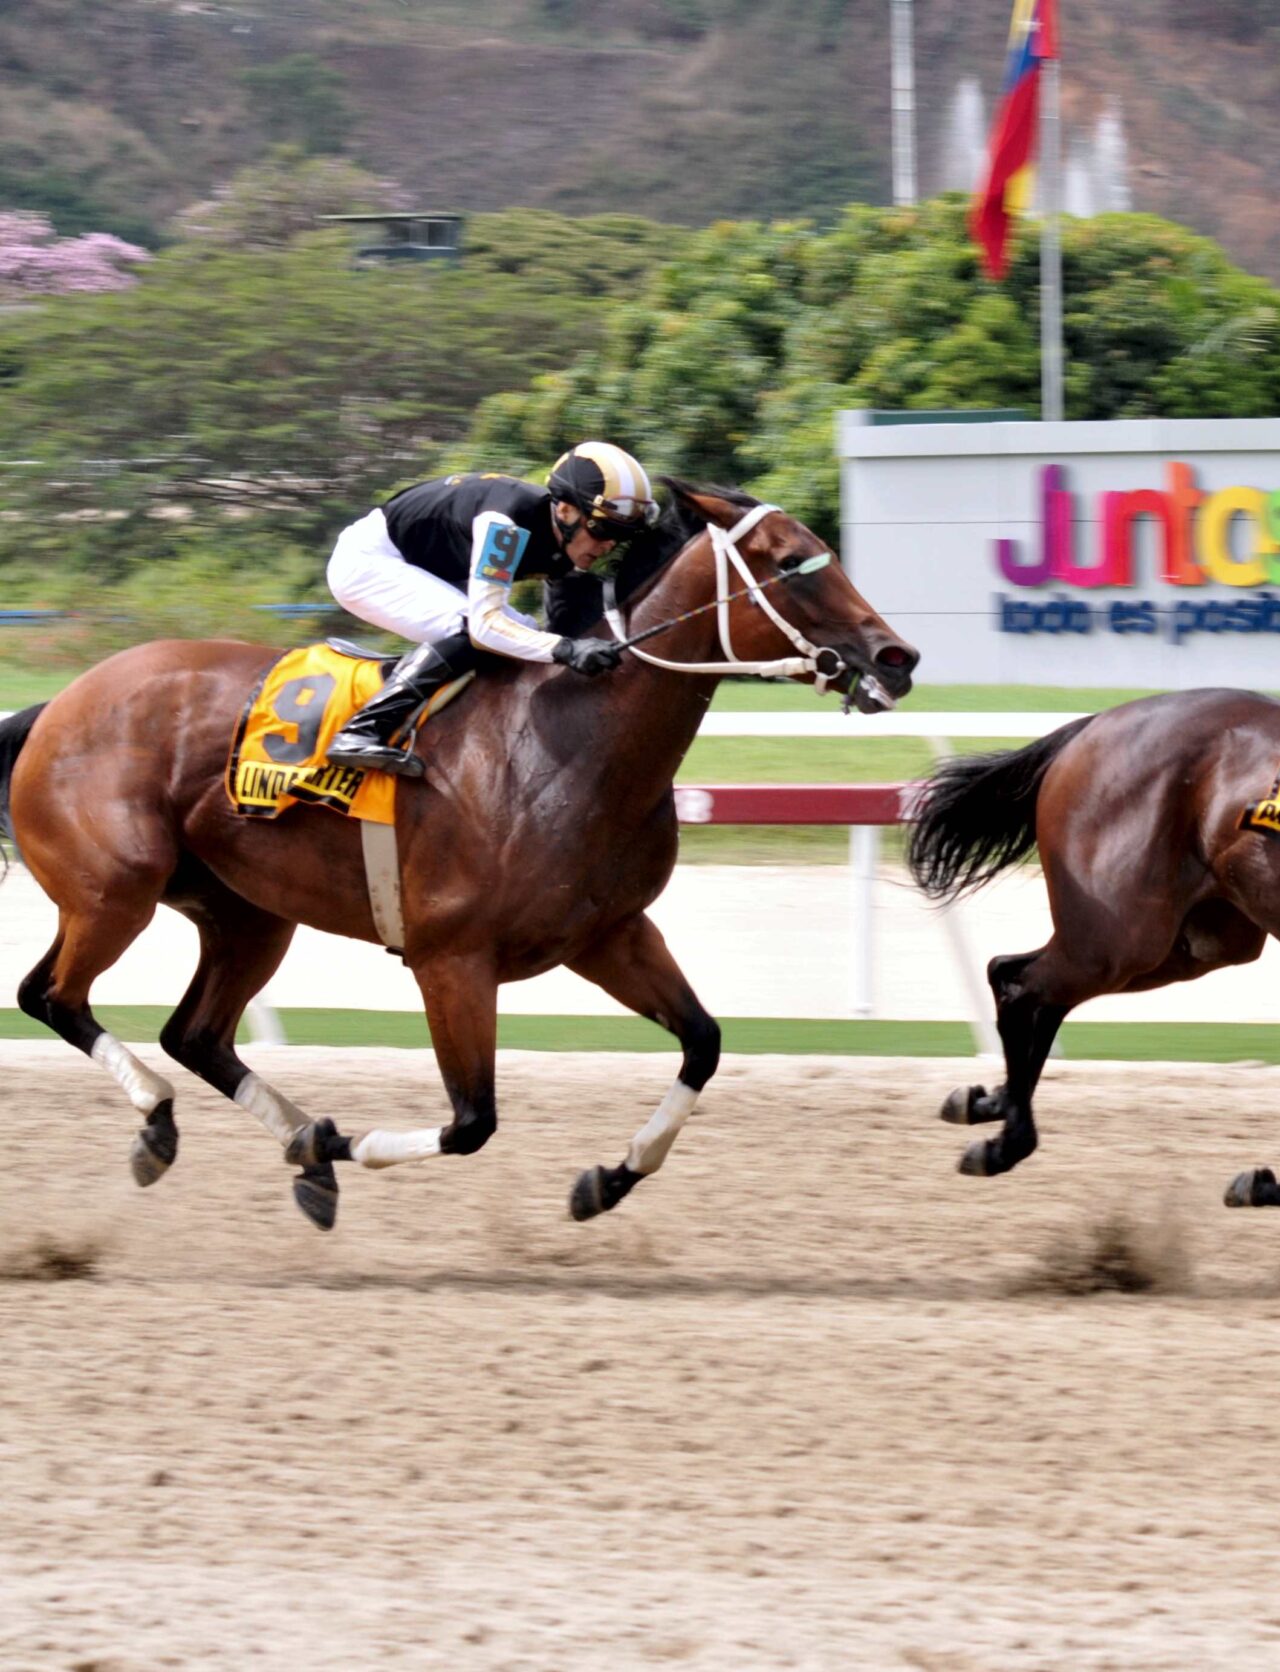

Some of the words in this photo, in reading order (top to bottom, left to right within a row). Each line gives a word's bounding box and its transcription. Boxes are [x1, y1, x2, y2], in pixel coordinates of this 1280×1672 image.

[488, 528, 520, 568] 9
[994, 592, 1091, 634] todo
[1108, 600, 1158, 635] es
[262, 672, 337, 765] 9
